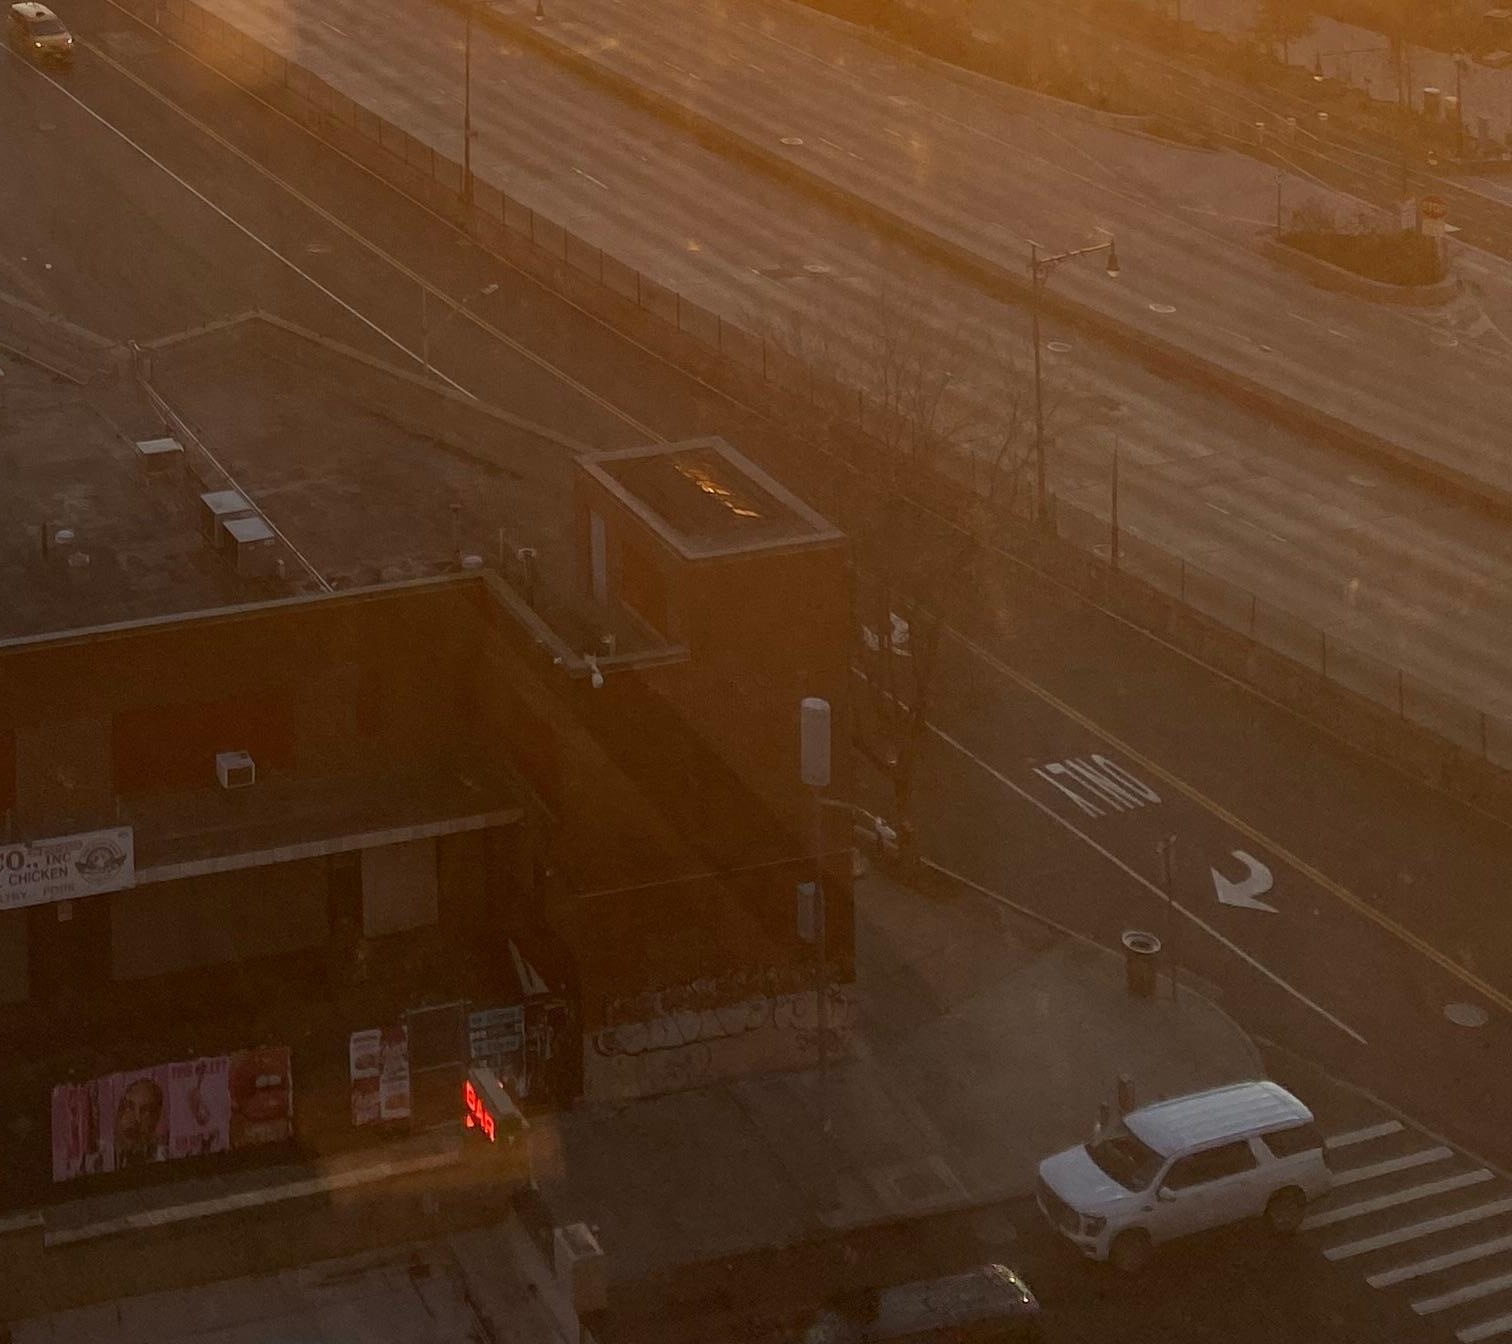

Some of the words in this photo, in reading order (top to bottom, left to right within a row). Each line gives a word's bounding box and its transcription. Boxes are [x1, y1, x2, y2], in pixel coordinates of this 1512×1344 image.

[1031, 753, 1162, 818] ONLY
[8, 866, 69, 887] CHICKEN
[463, 1079, 496, 1143] BAR
